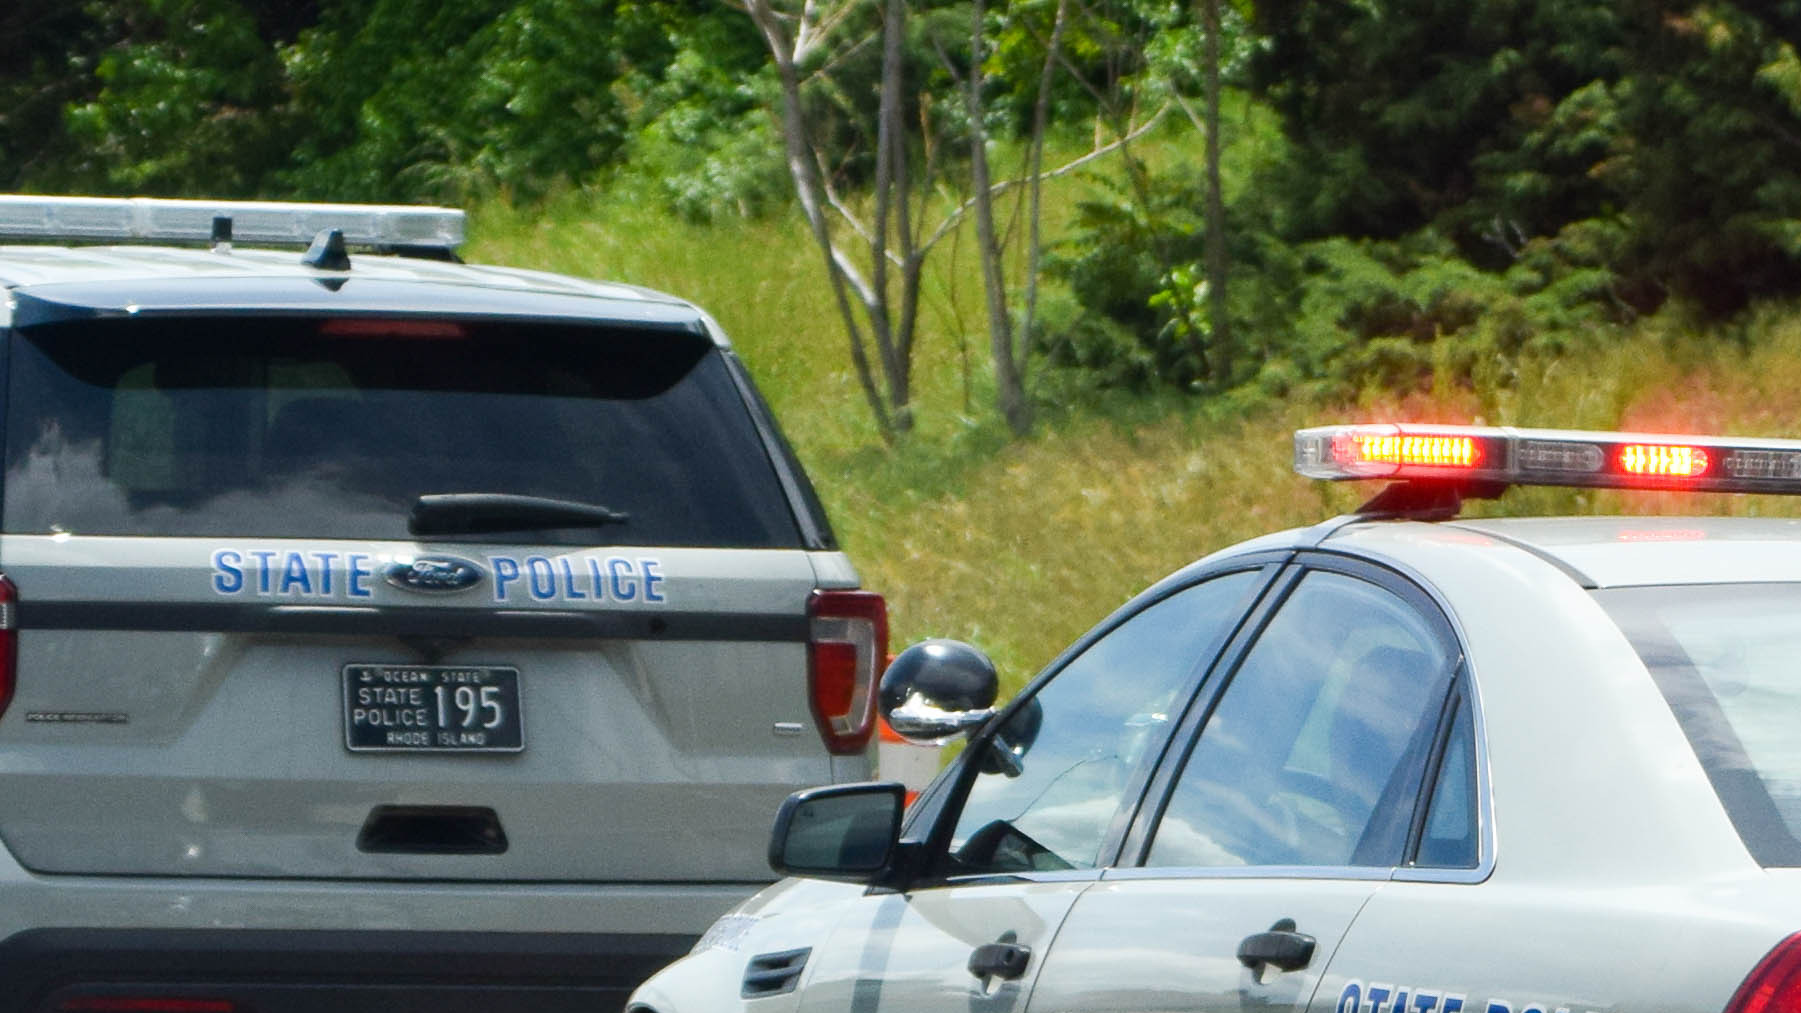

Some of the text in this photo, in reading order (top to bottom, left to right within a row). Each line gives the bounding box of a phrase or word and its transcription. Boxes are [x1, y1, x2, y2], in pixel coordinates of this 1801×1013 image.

[213, 549, 374, 598] STATE
[489, 555, 666, 603] POLICE
[384, 671, 481, 683] OCEAN STATE
[358, 687, 422, 705] STATE
[434, 686, 503, 729] 195
[353, 708, 428, 726] POLICE
[386, 732, 487, 745] RHODE ISLAND
